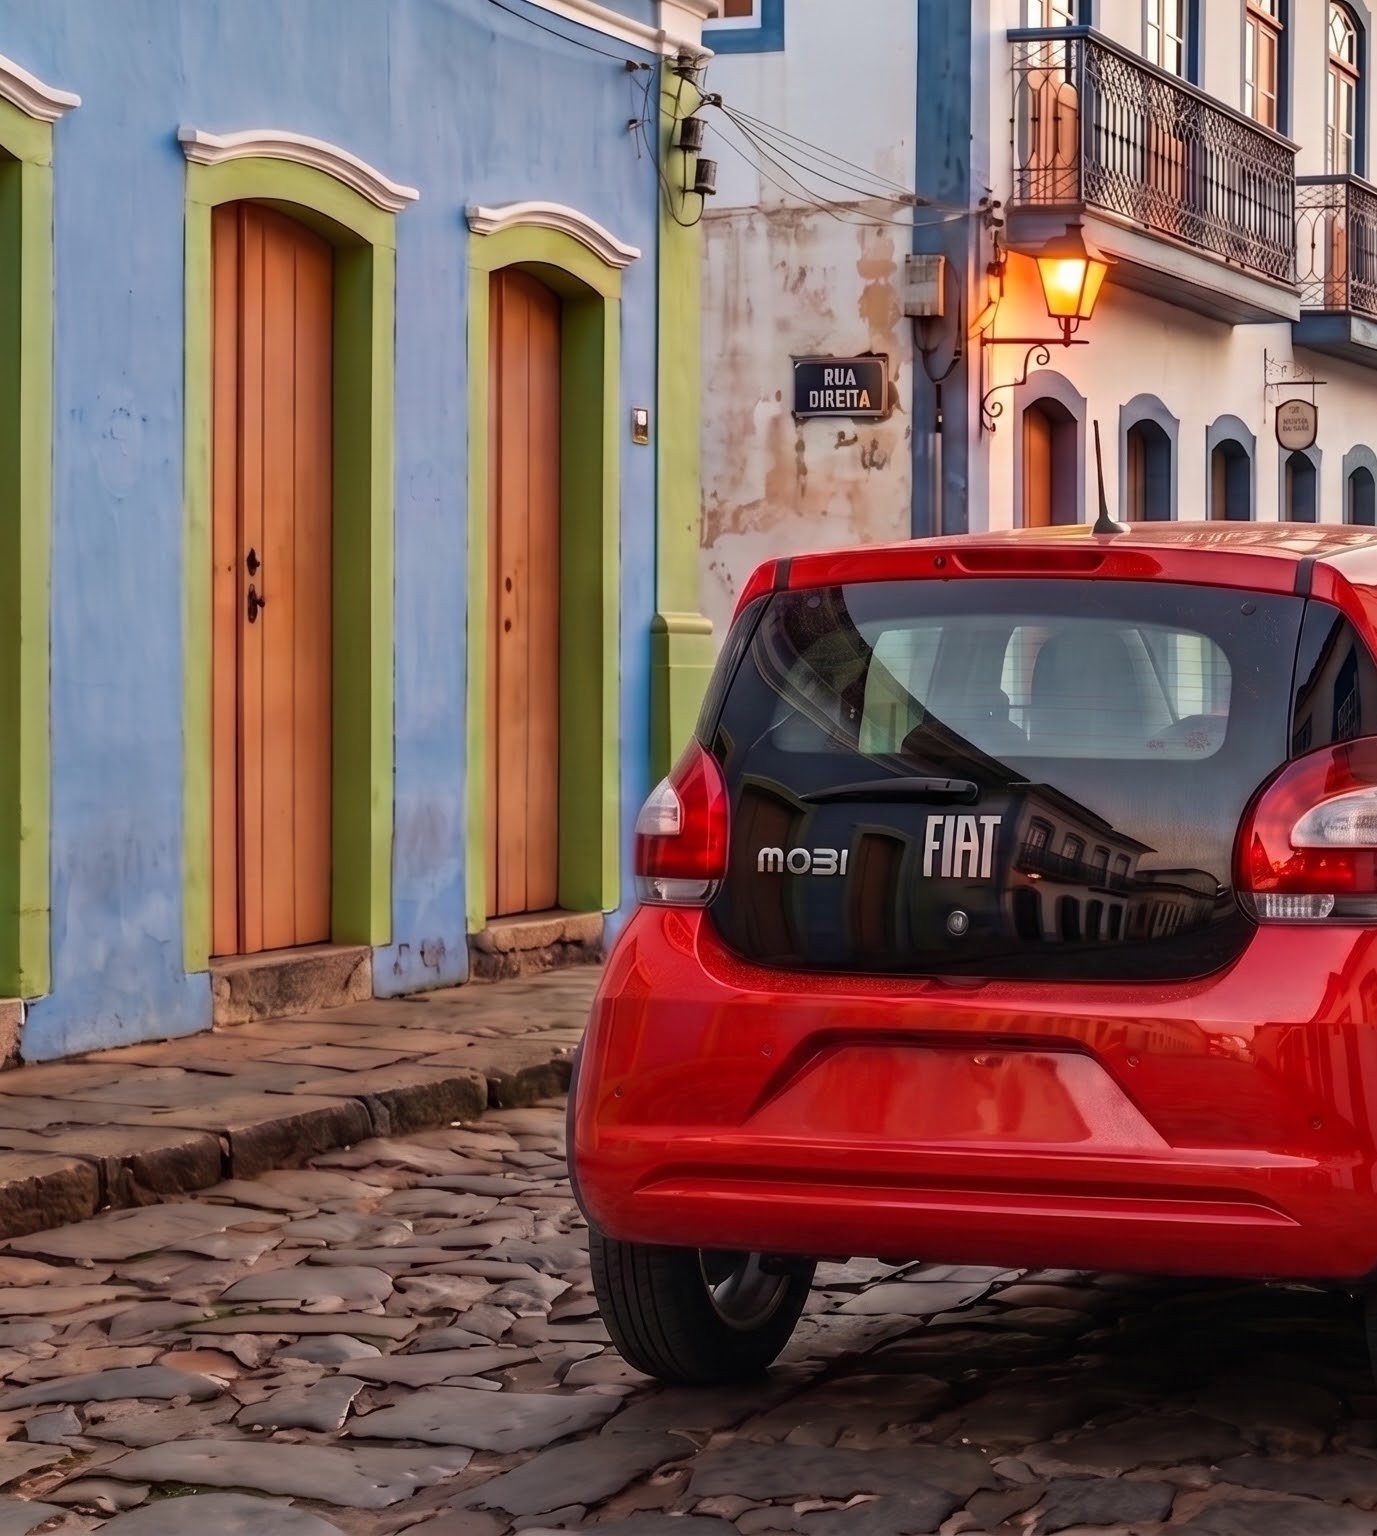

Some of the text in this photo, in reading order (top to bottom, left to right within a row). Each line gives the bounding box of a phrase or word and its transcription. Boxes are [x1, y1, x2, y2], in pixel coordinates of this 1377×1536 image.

[824, 368, 856, 386] RUA
[809, 389, 871, 408] DIREITA
[923, 815, 1002, 878] FIAT
[757, 847, 849, 875] MOBI
